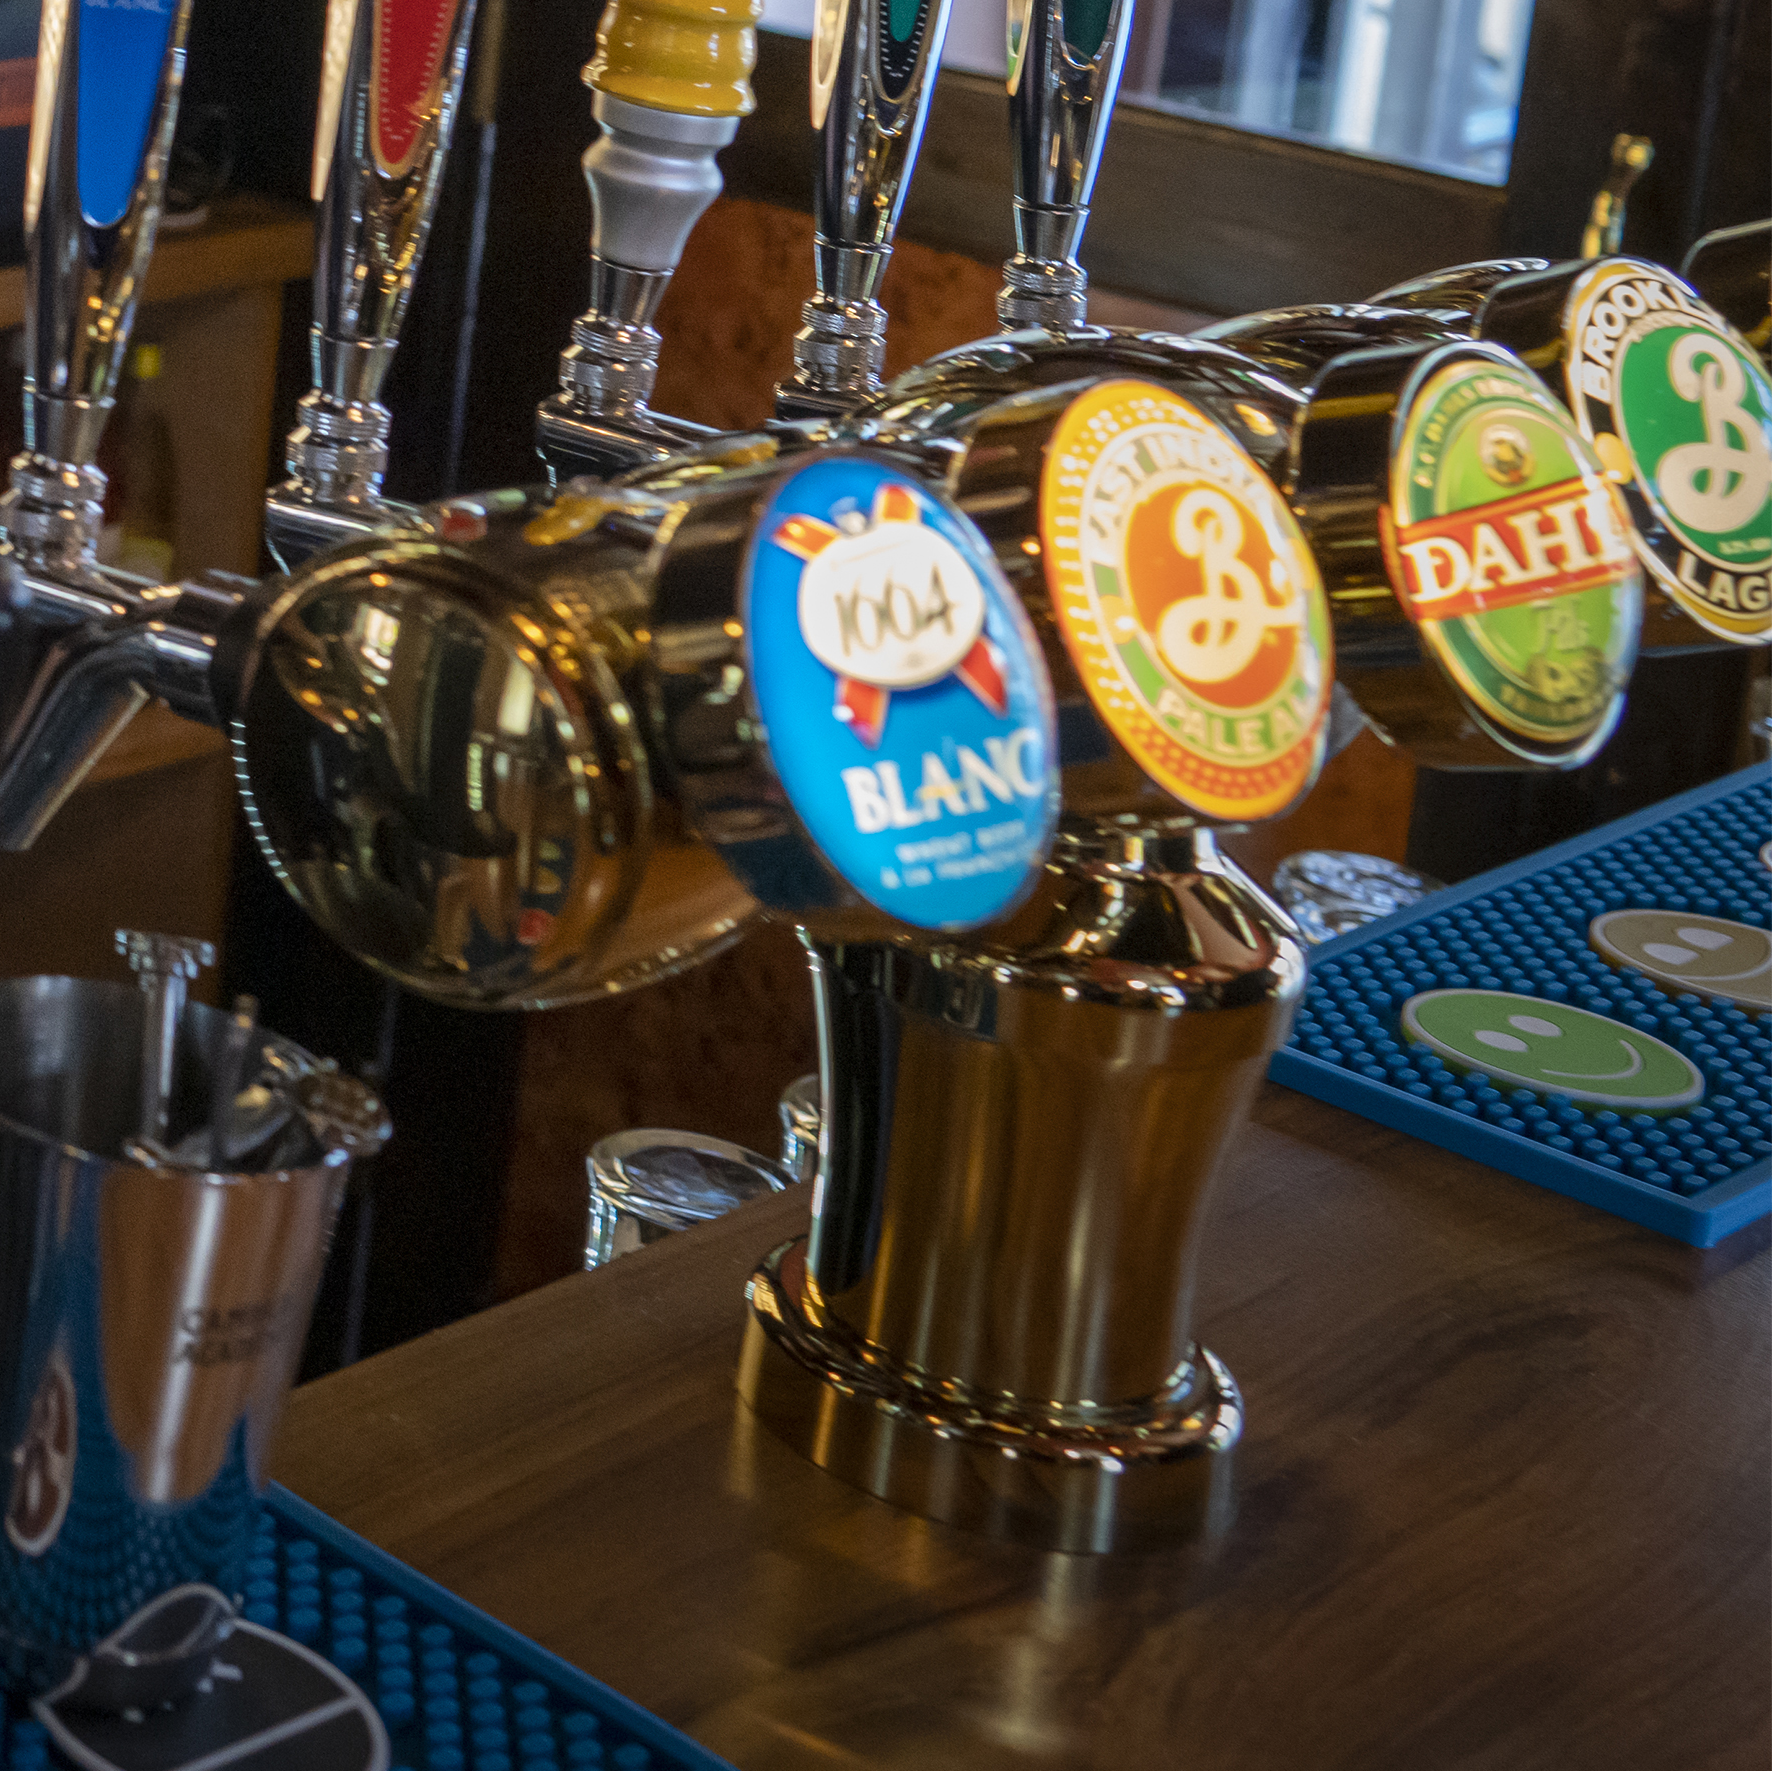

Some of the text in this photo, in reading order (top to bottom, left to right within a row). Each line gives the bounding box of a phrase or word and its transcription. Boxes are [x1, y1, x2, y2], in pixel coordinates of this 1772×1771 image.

[1581, 278, 1700, 404] BROOKL
[1676, 548, 1772, 612] LAG
[1158, 686, 1263, 755] PALE
[840, 727, 1048, 834] BLANC
